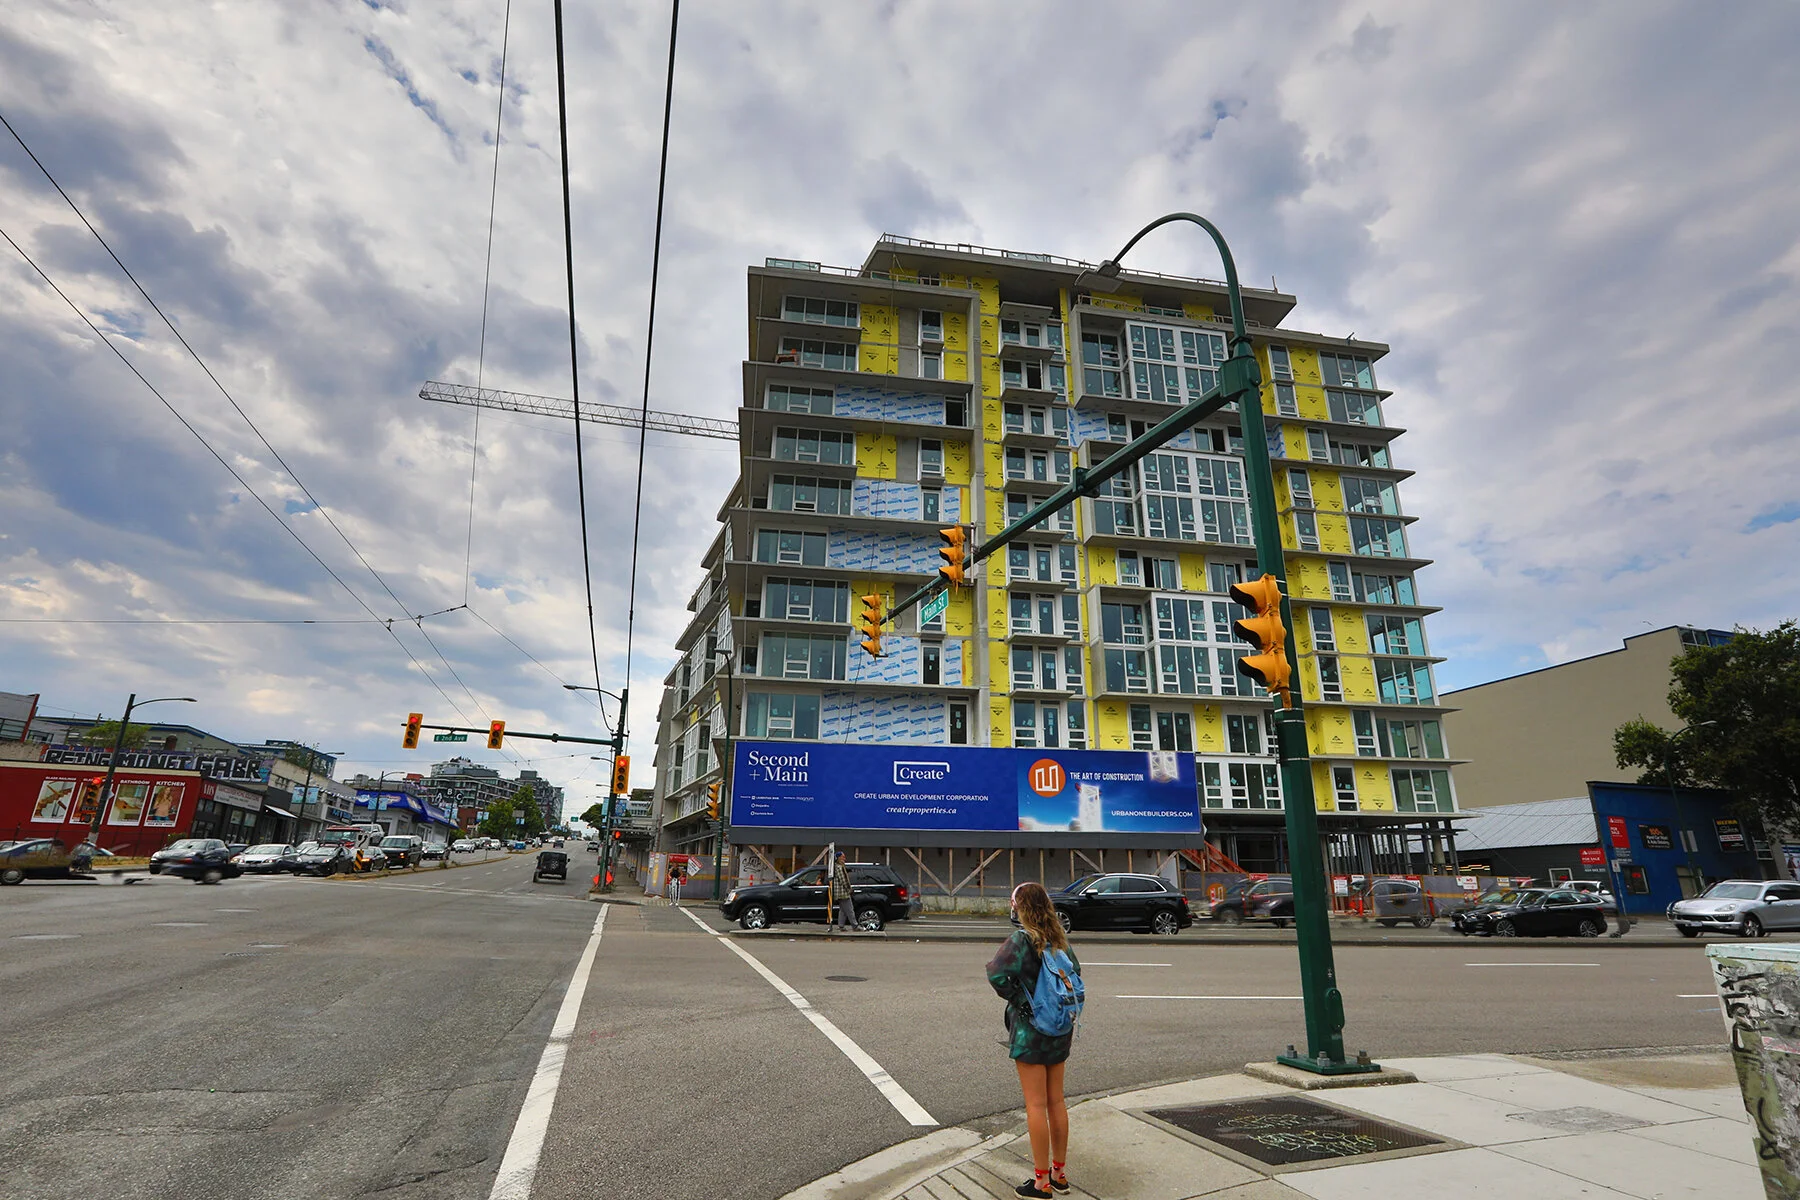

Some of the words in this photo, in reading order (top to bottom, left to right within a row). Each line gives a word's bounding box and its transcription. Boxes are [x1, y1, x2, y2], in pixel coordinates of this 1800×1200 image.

[924, 603, 938, 621] Main
[938, 596, 944, 610] St
[748, 750, 809, 767] Second
[764, 766, 809, 782] Main
[900, 767, 944, 780] Create
[1070, 772, 1081, 780] THE
[1082, 772, 1093, 780] ART
[1094, 772, 1101, 780] OF
[1102, 773, 1144, 781] CONSTRUCTION
[886, 806, 957, 815] createproperties.ca
[1111, 810, 1193, 818] URBANONEBUILDERS.COM
